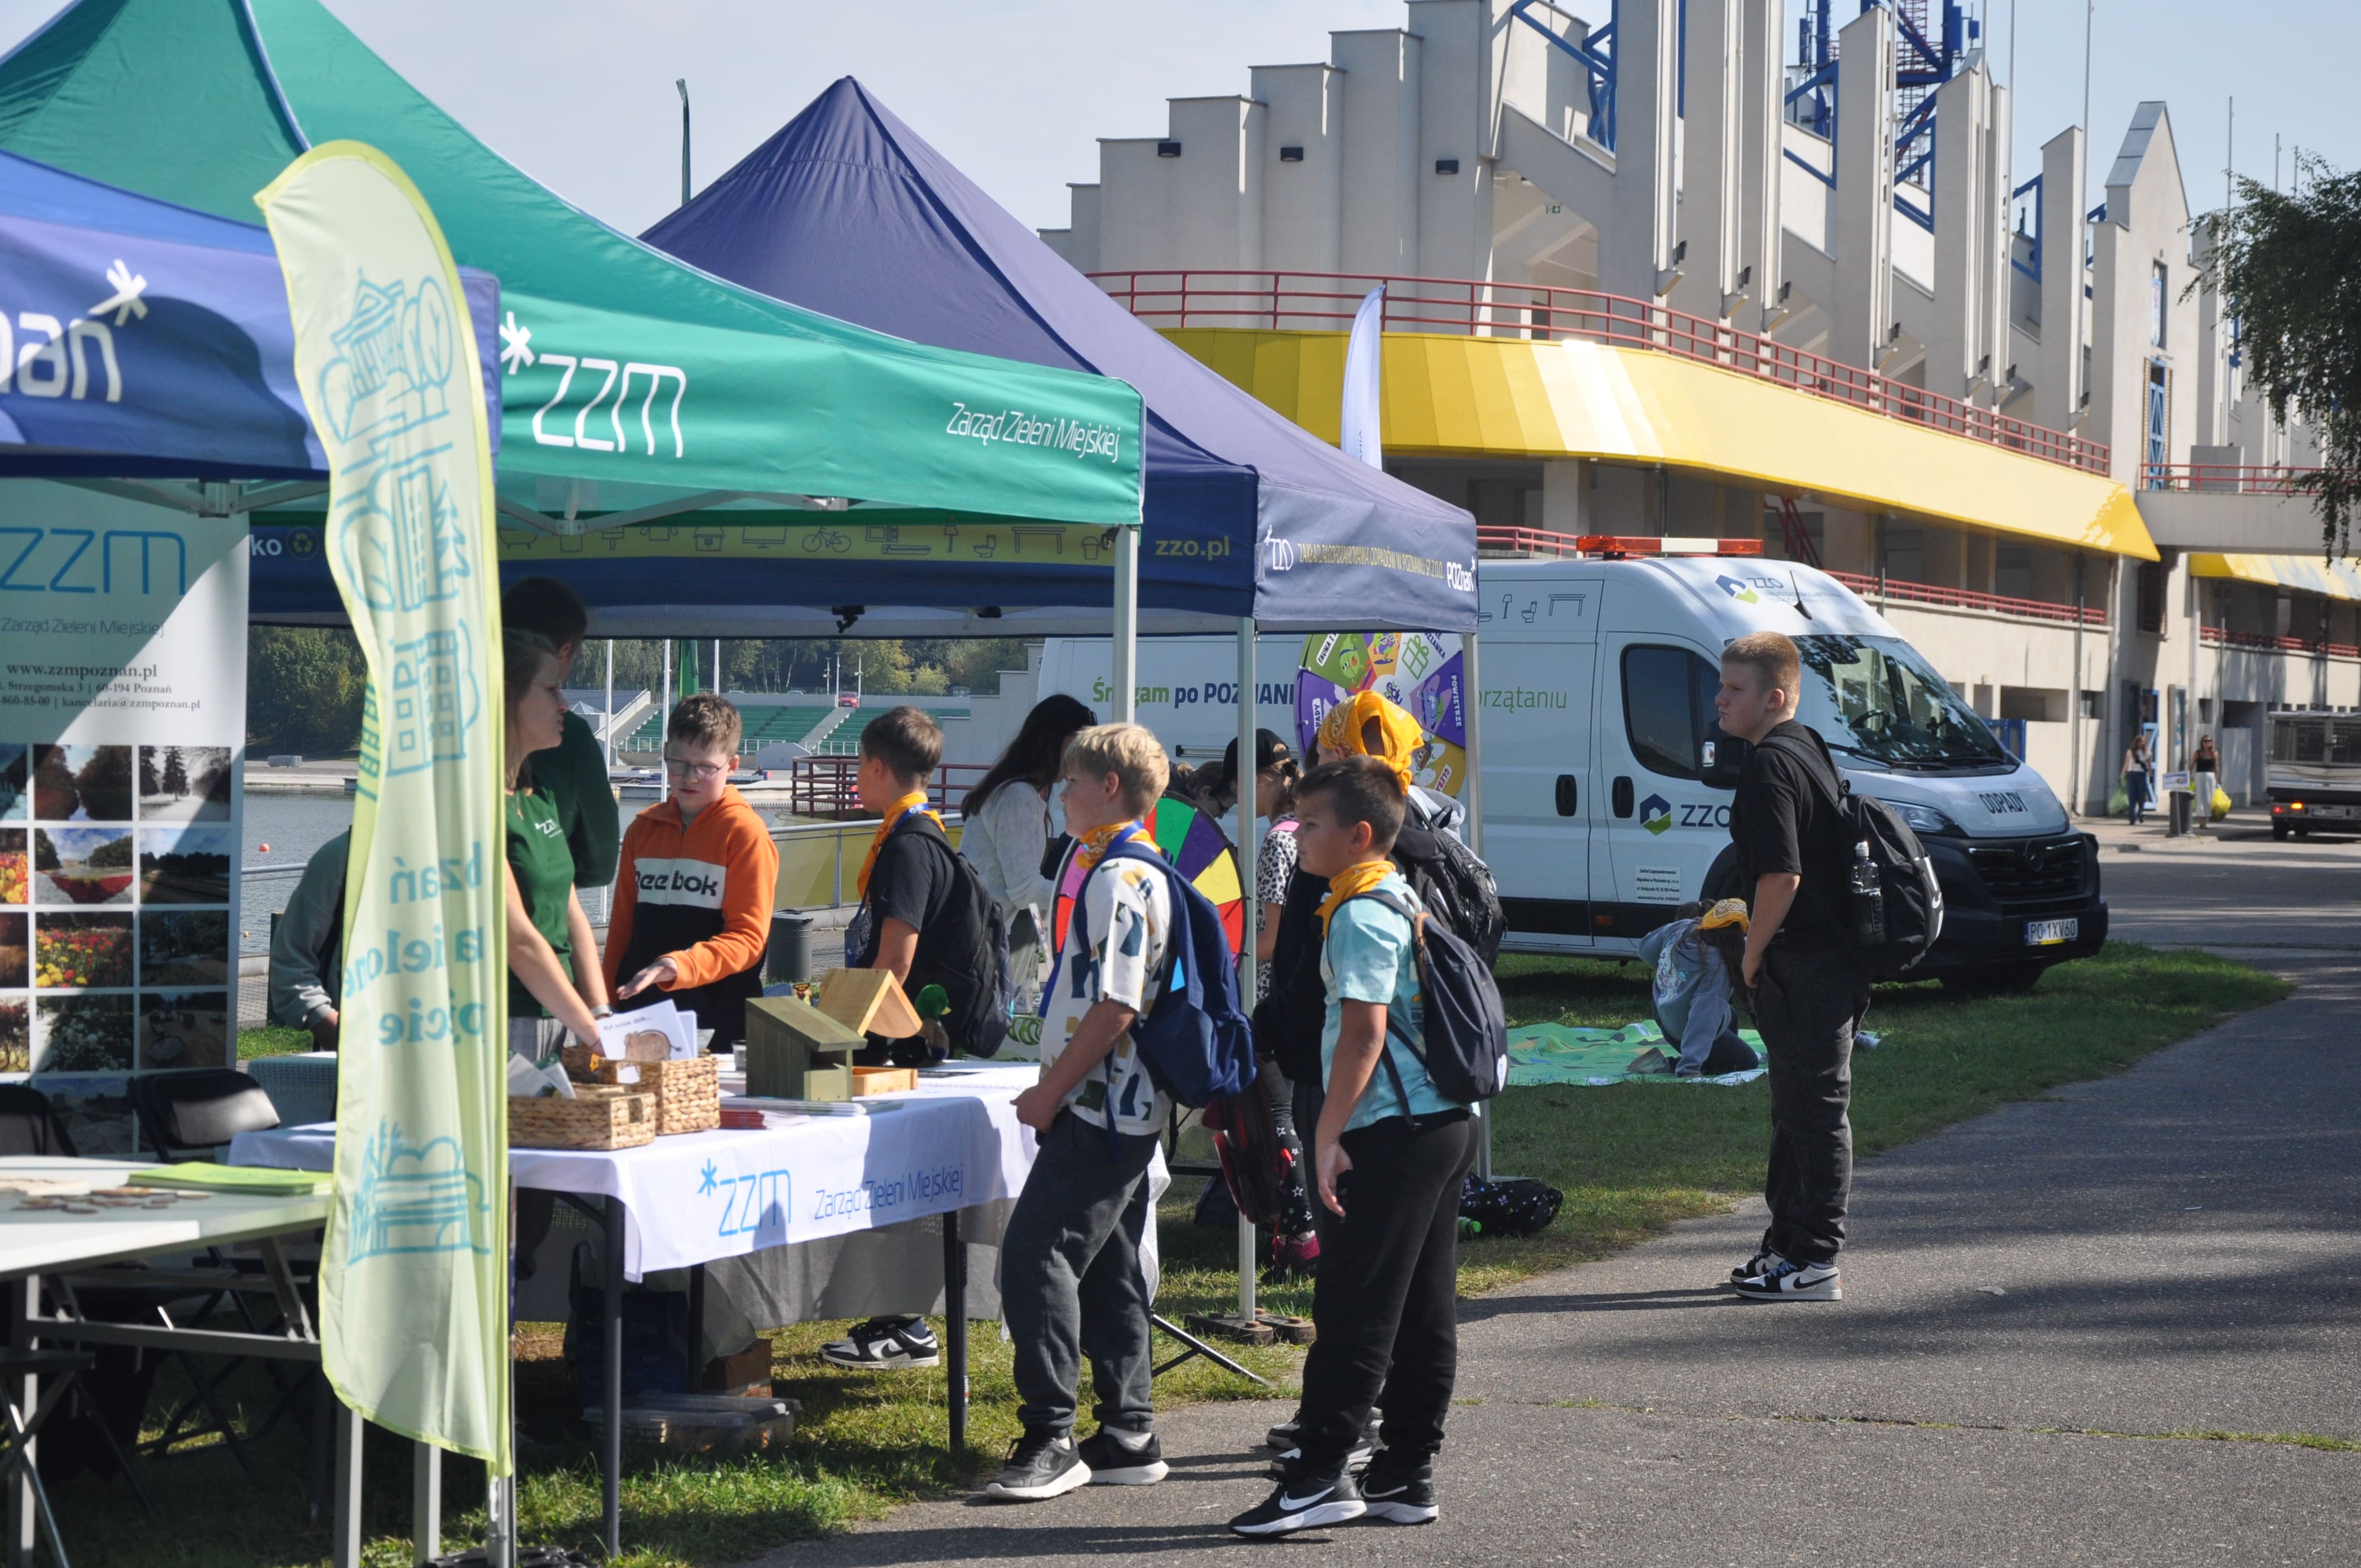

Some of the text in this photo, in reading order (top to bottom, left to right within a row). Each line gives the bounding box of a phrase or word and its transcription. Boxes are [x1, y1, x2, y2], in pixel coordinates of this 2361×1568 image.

[946, 402, 1120, 462] Zarząd Zieleni Miejskiej
[1155, 536, 1230, 560] zzo.pl
[1, 618, 165, 638] Zarząd Zieleni Miejskiej
[1318, 642, 1331, 664] FAUNA
[7, 664, 157, 681] www.zzmpoznan.pl
[8, 682, 73, 693] Strzegomska
[77, 683, 83, 692] 3
[96, 683, 130, 693] 60-194
[134, 683, 172, 693] Poznań
[1174, 687, 1198, 709] po
[1451, 675, 1462, 727] POWIETRZE
[1978, 792, 2028, 814] ODPADY
[2031, 923, 2043, 941] PO
[814, 1163, 964, 1219] Zarząd Zieleni Miejskiej
